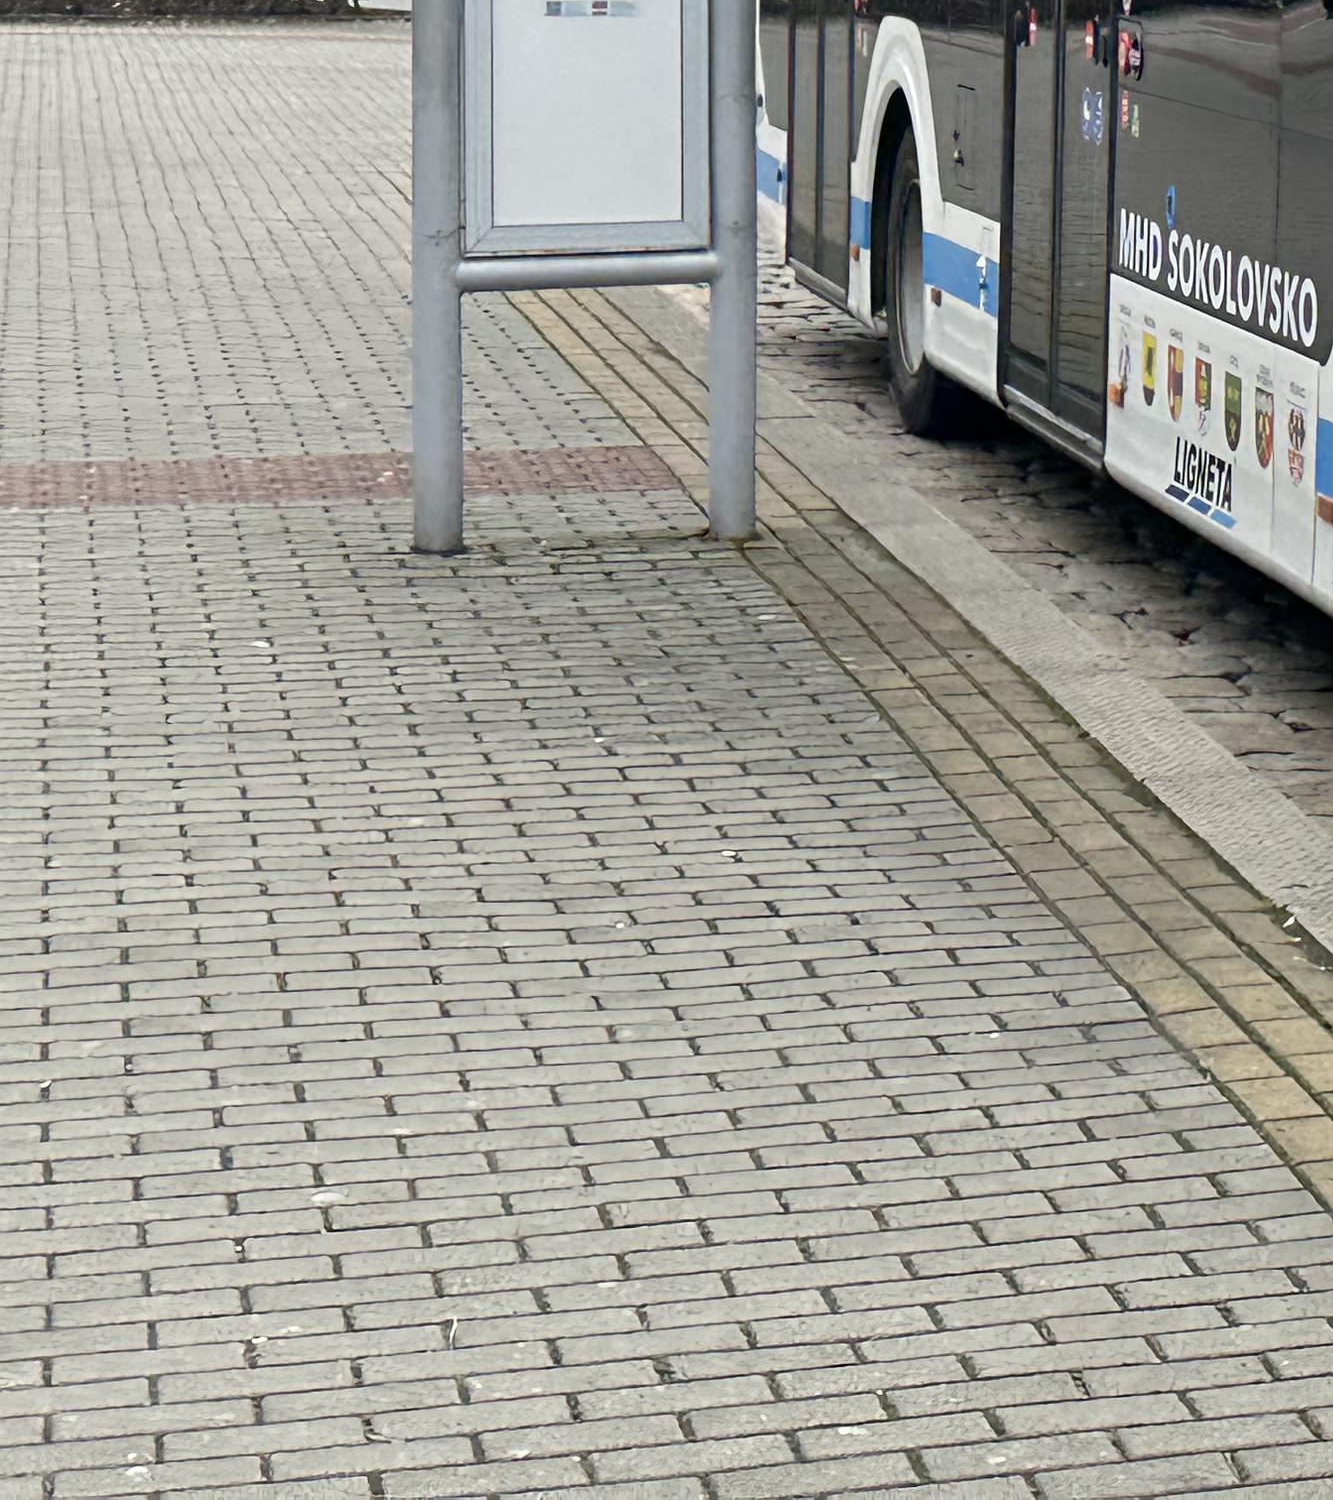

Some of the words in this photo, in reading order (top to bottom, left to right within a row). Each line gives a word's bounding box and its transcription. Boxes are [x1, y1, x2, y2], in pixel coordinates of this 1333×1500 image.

[1118, 207, 1163, 282] MHD
[1166, 228, 1318, 348] SOKOLOVSKO
[1174, 436, 1232, 512] LIGNETA
